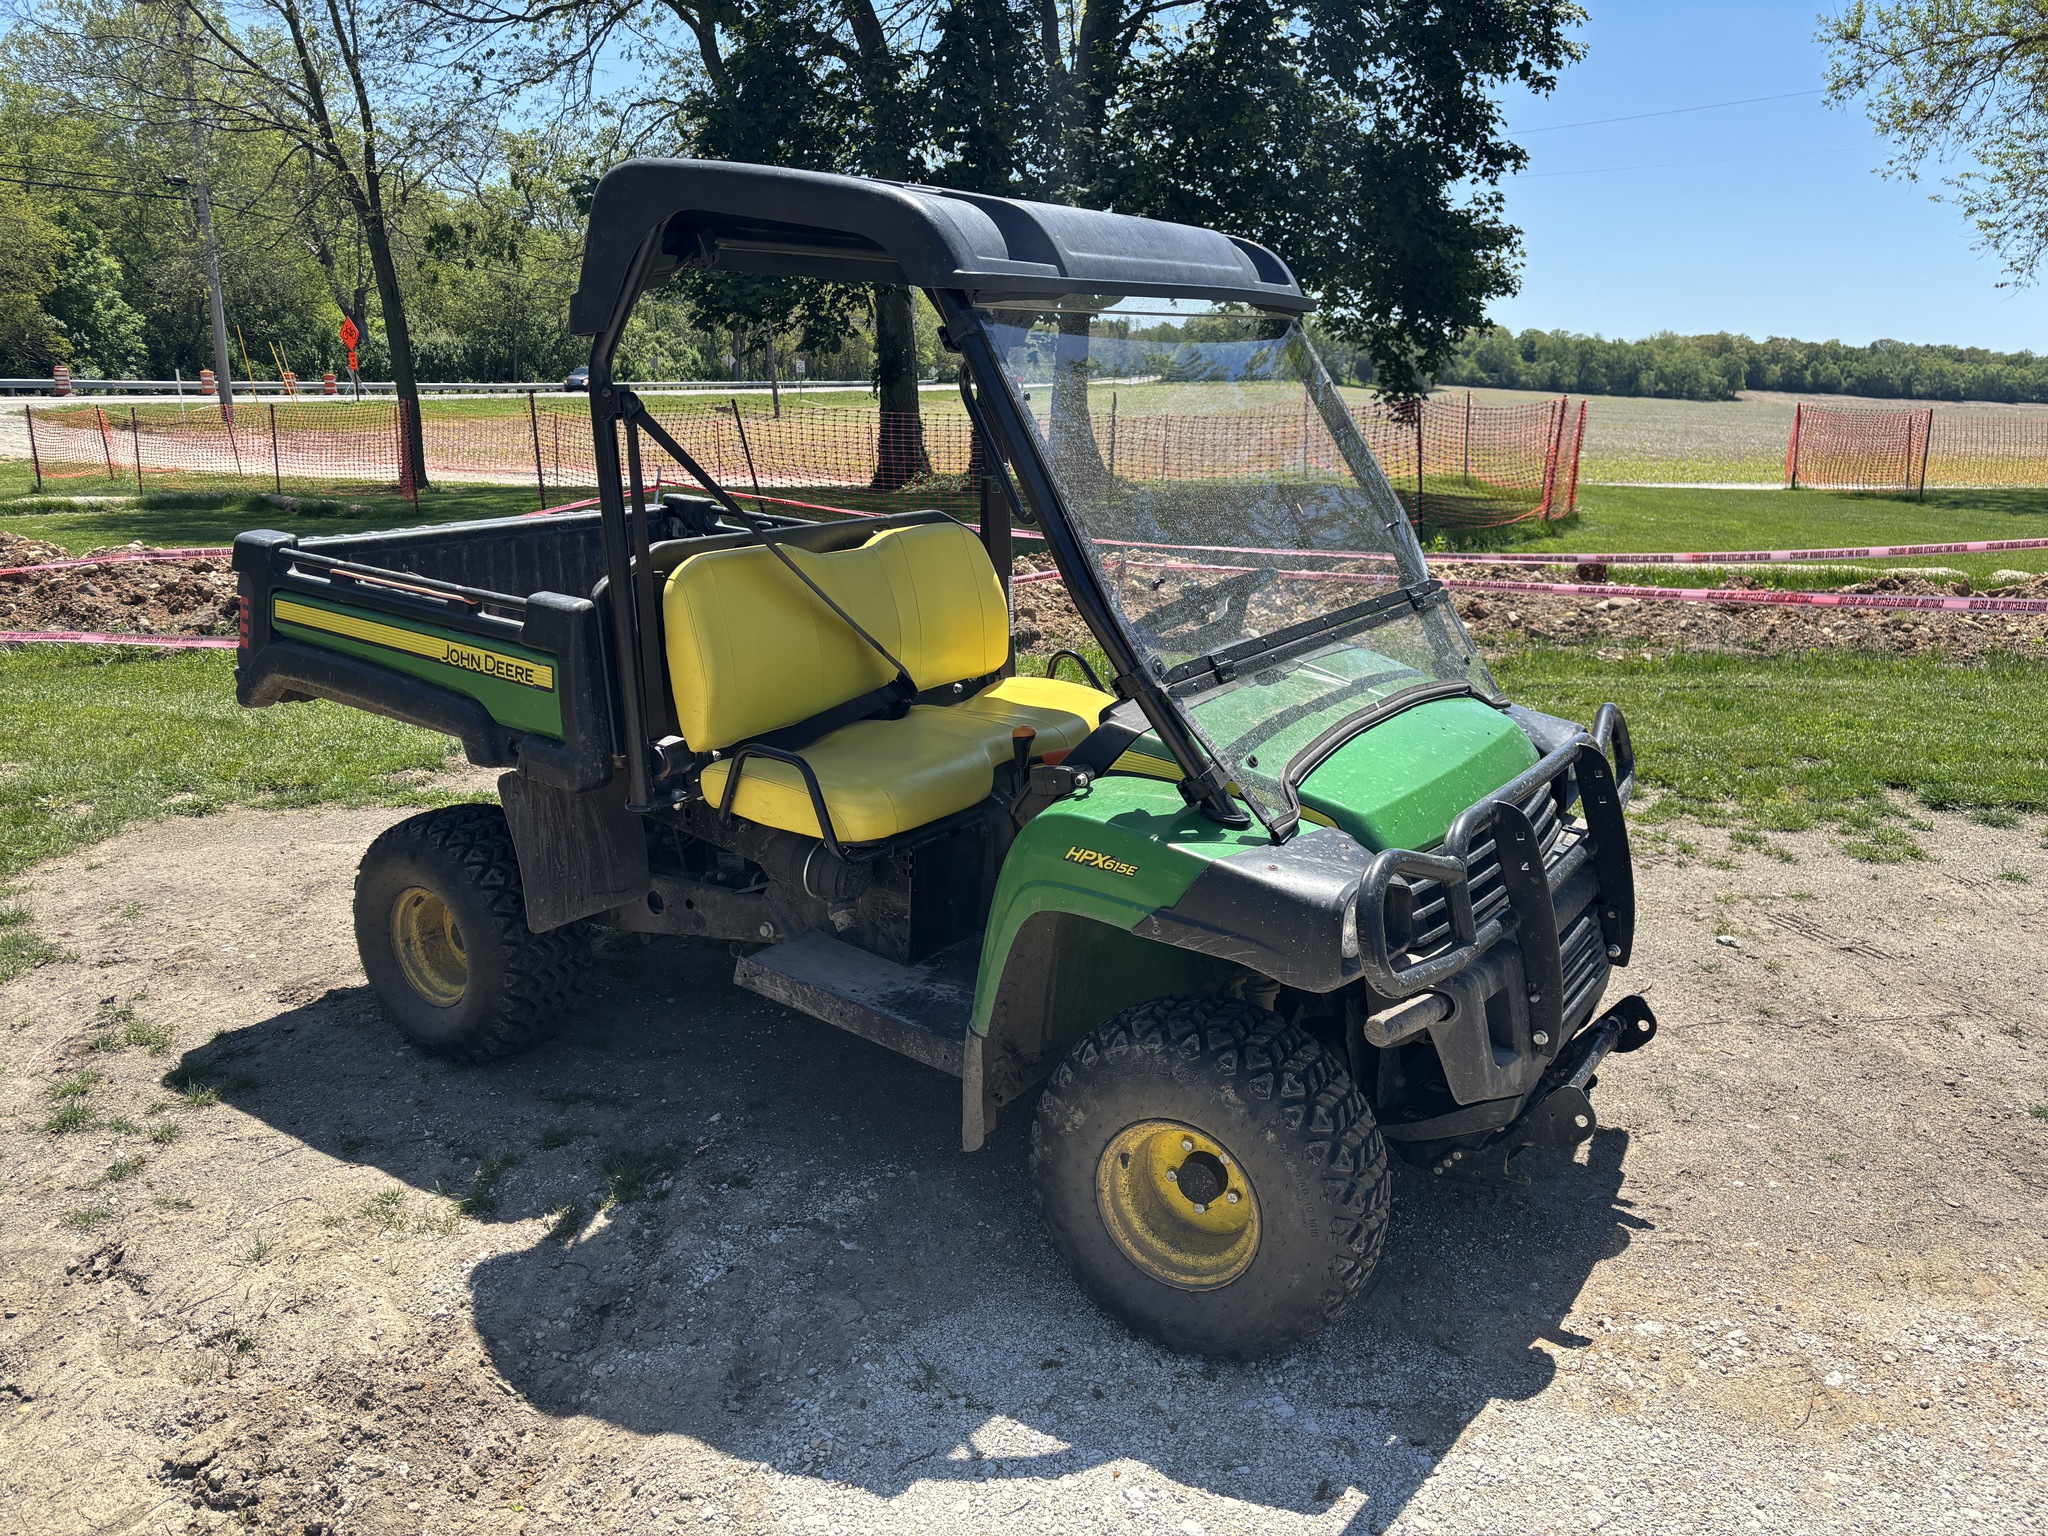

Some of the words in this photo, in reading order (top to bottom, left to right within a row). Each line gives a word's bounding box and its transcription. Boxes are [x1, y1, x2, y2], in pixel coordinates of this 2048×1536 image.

[442, 644, 480, 670] JOHN
[484, 655, 534, 683] DEERE
[1064, 846, 1138, 876] HPX615E
